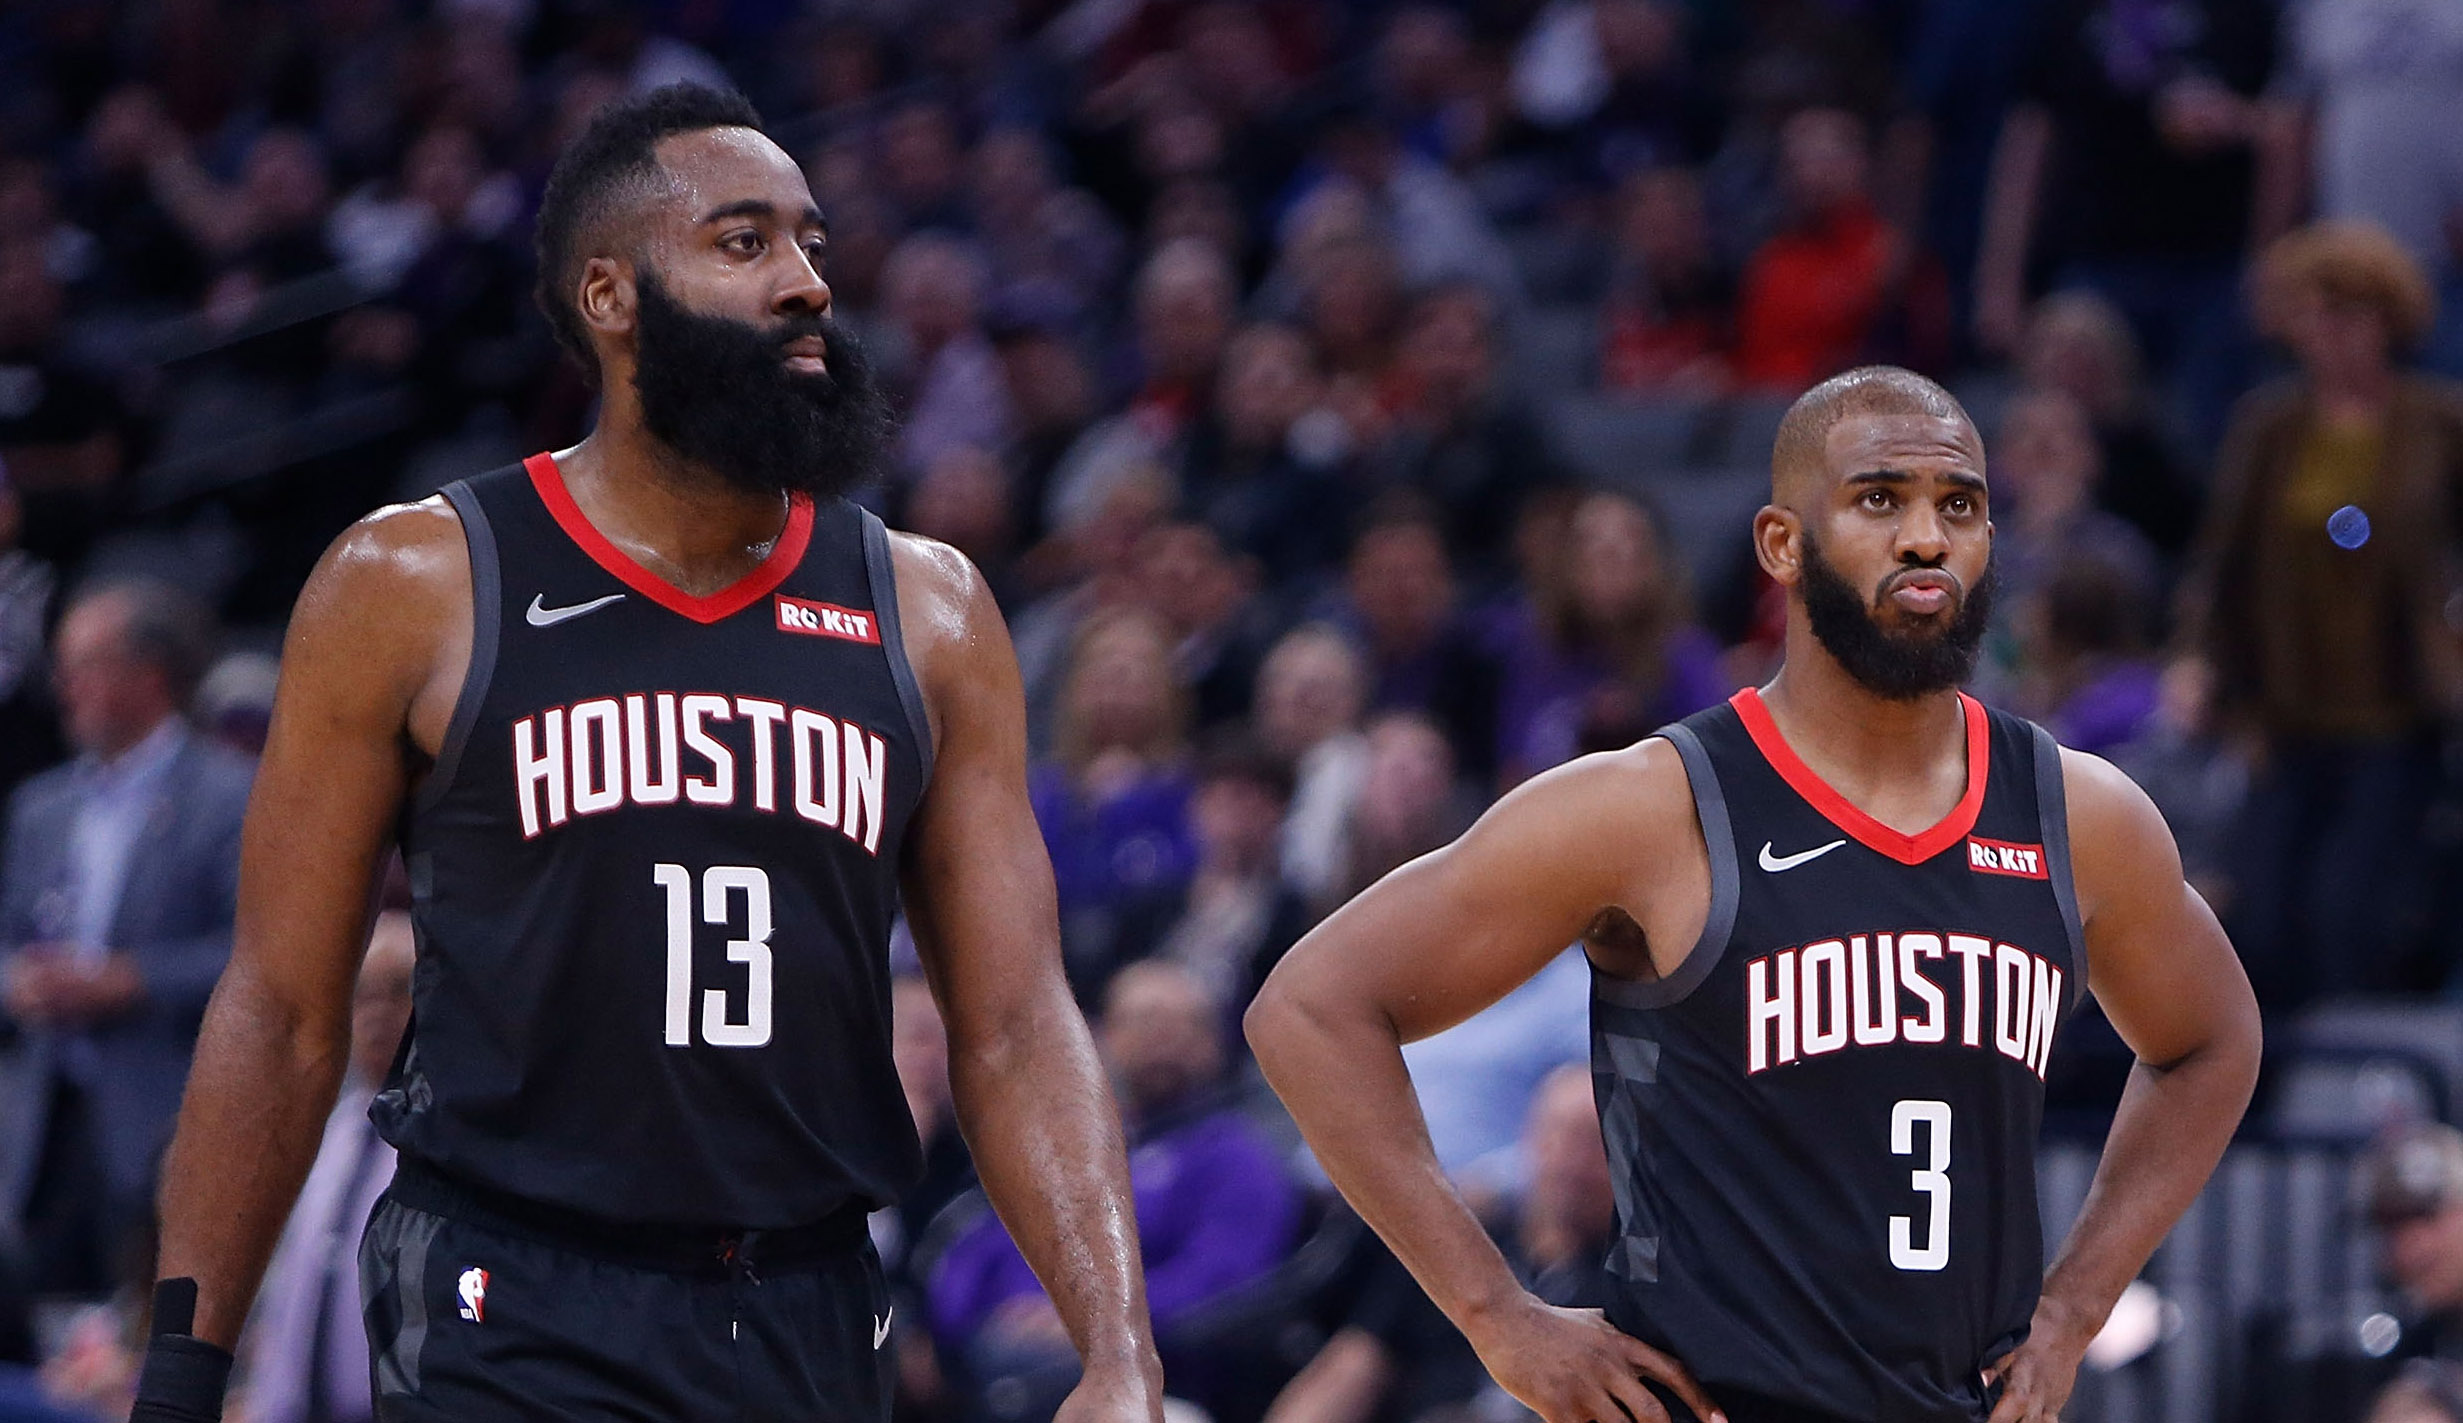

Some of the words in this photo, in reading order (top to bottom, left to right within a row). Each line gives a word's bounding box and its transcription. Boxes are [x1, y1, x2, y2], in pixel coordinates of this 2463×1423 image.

[513, 692, 886, 857] HOUSTON
[654, 863, 772, 1046] 13
[1747, 932, 2064, 1081] HOUSTON
[1889, 1100, 1952, 1271] 3
